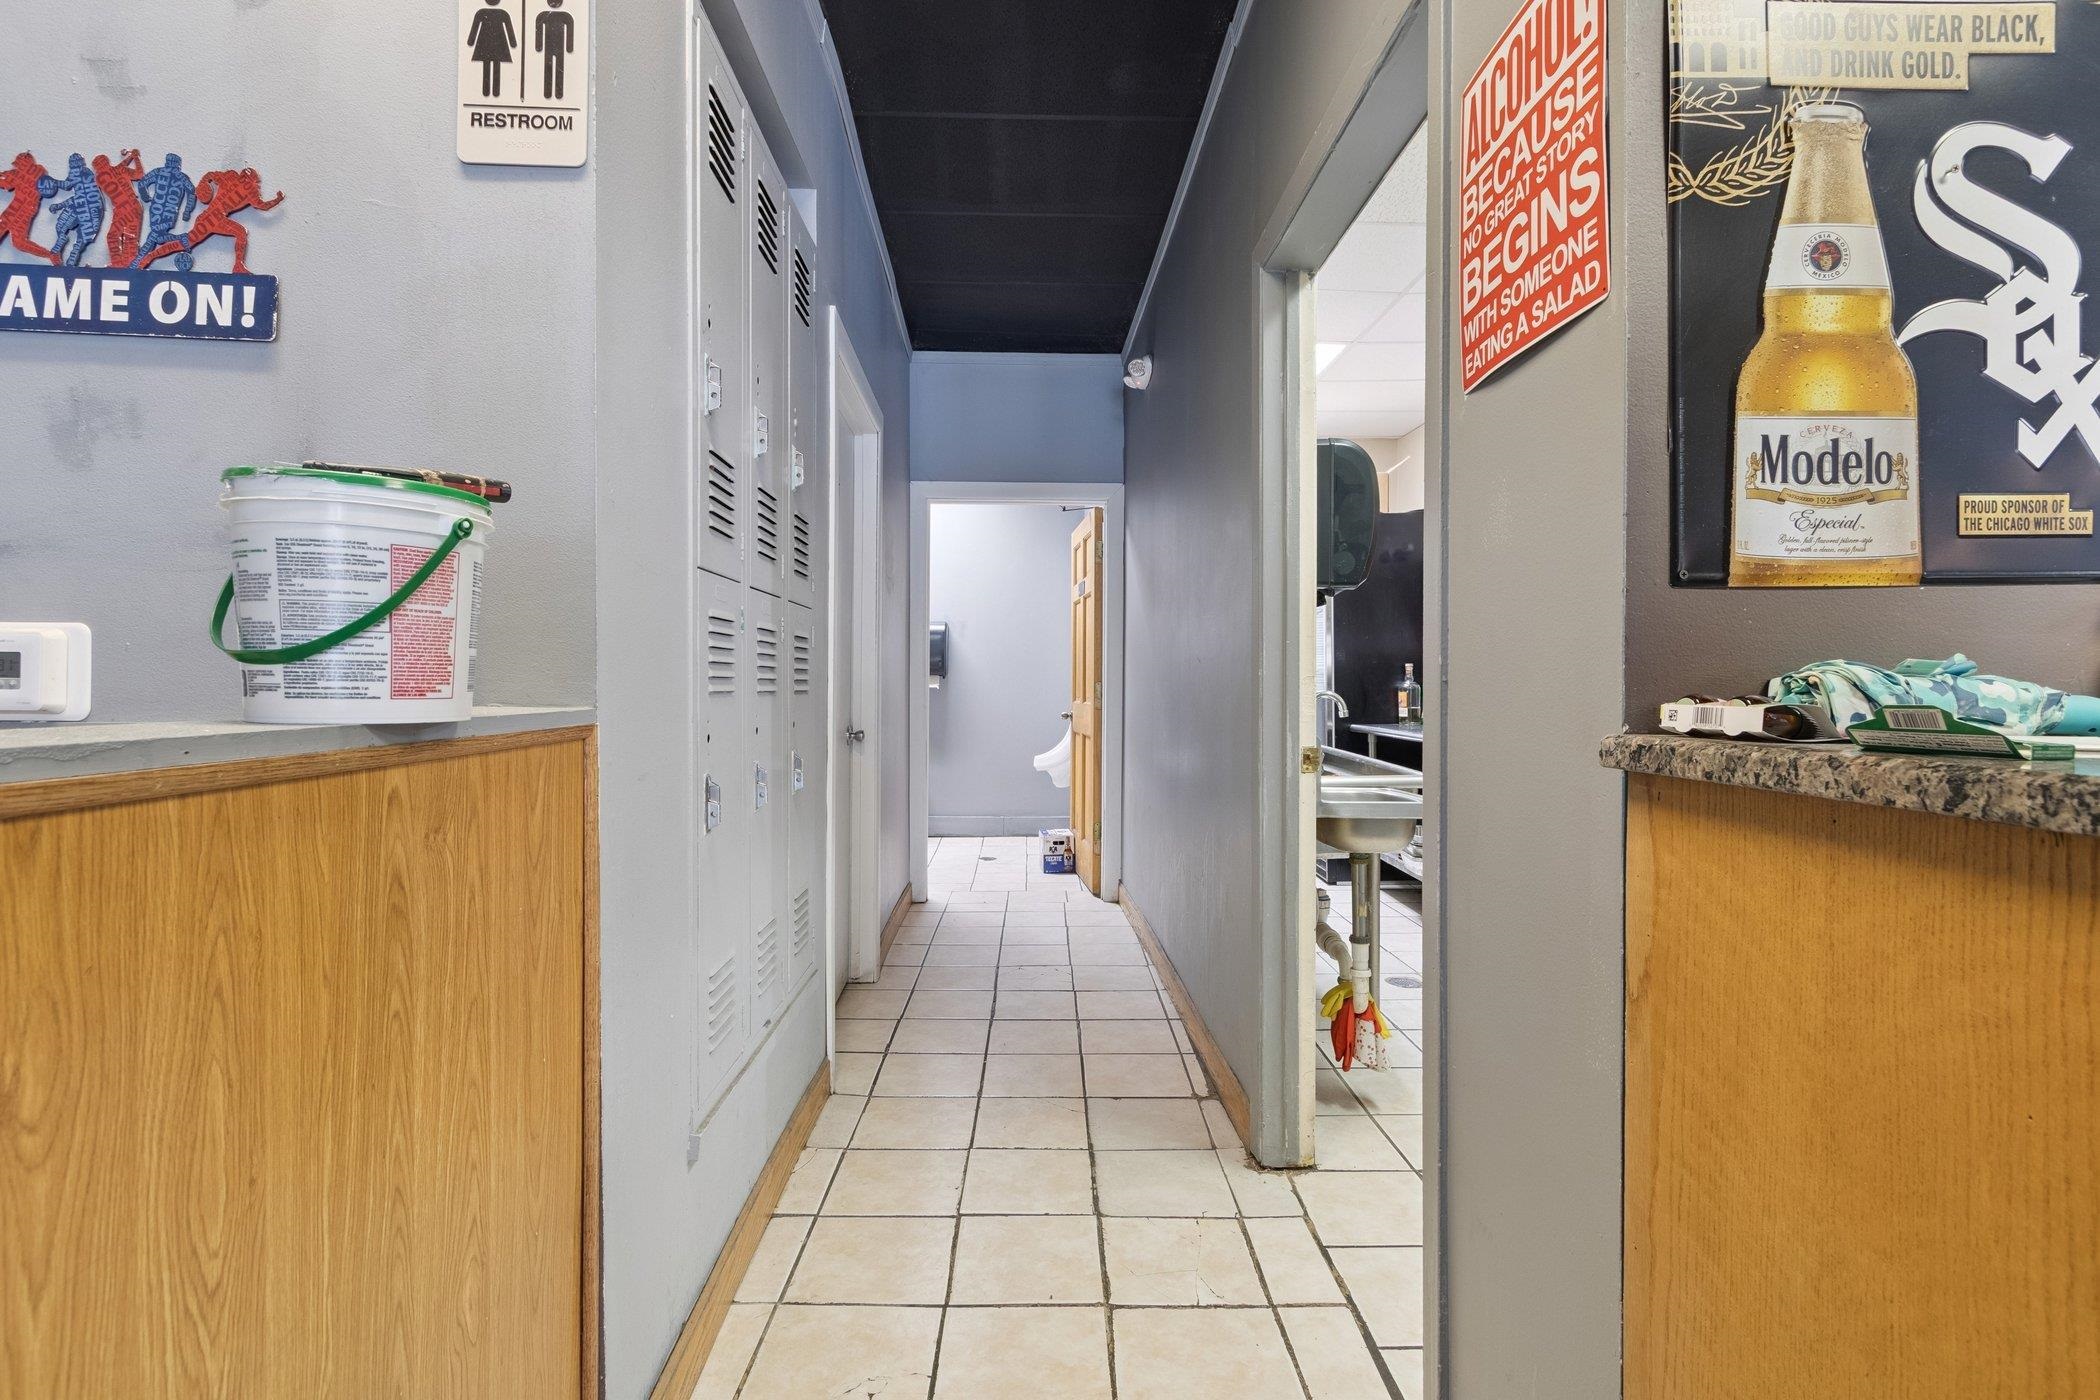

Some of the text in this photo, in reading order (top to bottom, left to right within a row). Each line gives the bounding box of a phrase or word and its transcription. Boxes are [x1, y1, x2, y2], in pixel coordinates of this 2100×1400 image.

[1780, 13, 2045, 46] GOOD GUYS WEAR BLACK,
[1781, 51, 1961, 79] AND DRINK GOLD.
[470, 112, 573, 130] RESTROOM
[1463, 45, 1599, 232] BECAUSE
[1463, 101, 1599, 259] NO GREAT STORY
[1463, 147, 1600, 316] BEGINS
[1464, 216, 1599, 347] WITH SOMEONE
[149, 280, 256, 328] ON!
[1465, 261, 1600, 379] EATING A SALAD
[1800, 424, 1853, 438] CERVEZA
[1760, 434, 1893, 486] Modelo
[1816, 496, 1838, 505] 1925
[1964, 499, 2065, 514] PROUD SPONSOR OF
[1789, 509, 1862, 535] Especial
[1963, 516, 2088, 531] THE CHICAGO WHITE SOX
